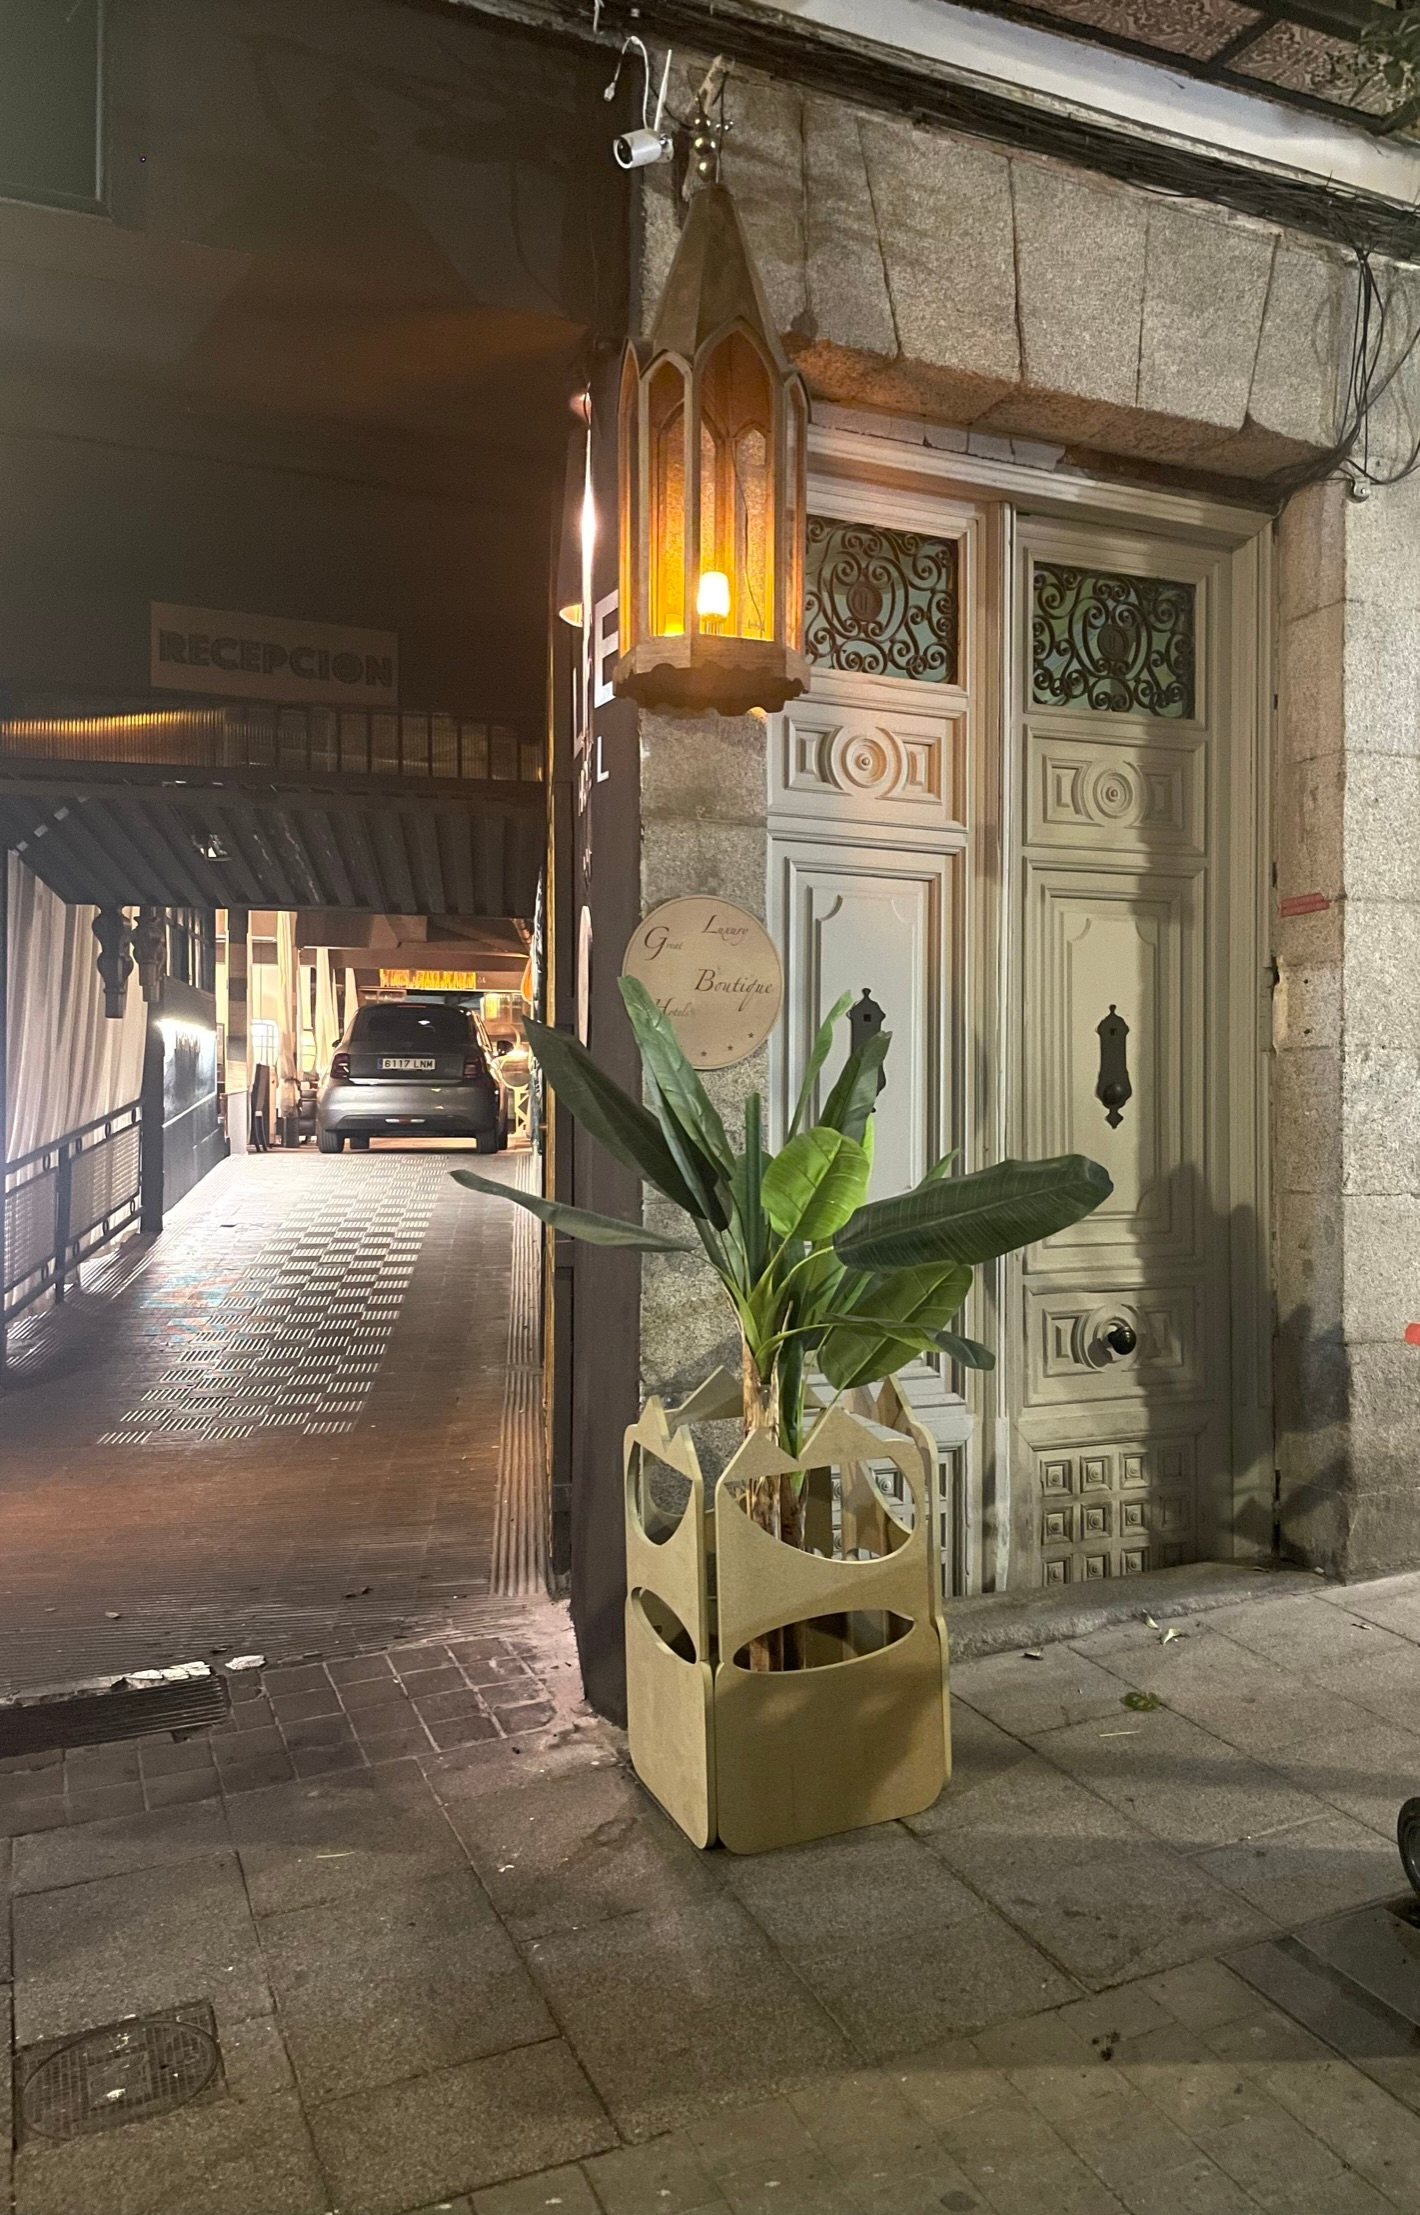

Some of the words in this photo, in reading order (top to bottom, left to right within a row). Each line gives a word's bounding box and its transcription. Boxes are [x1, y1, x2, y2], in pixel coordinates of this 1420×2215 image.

[158, 628, 393, 688] RECEPCION
[701, 914, 749, 947] Luxury
[694, 968, 774, 1012] Boutique
[384, 1060, 410, 1068] 6117
[413, 1060, 433, 1068] LNM
